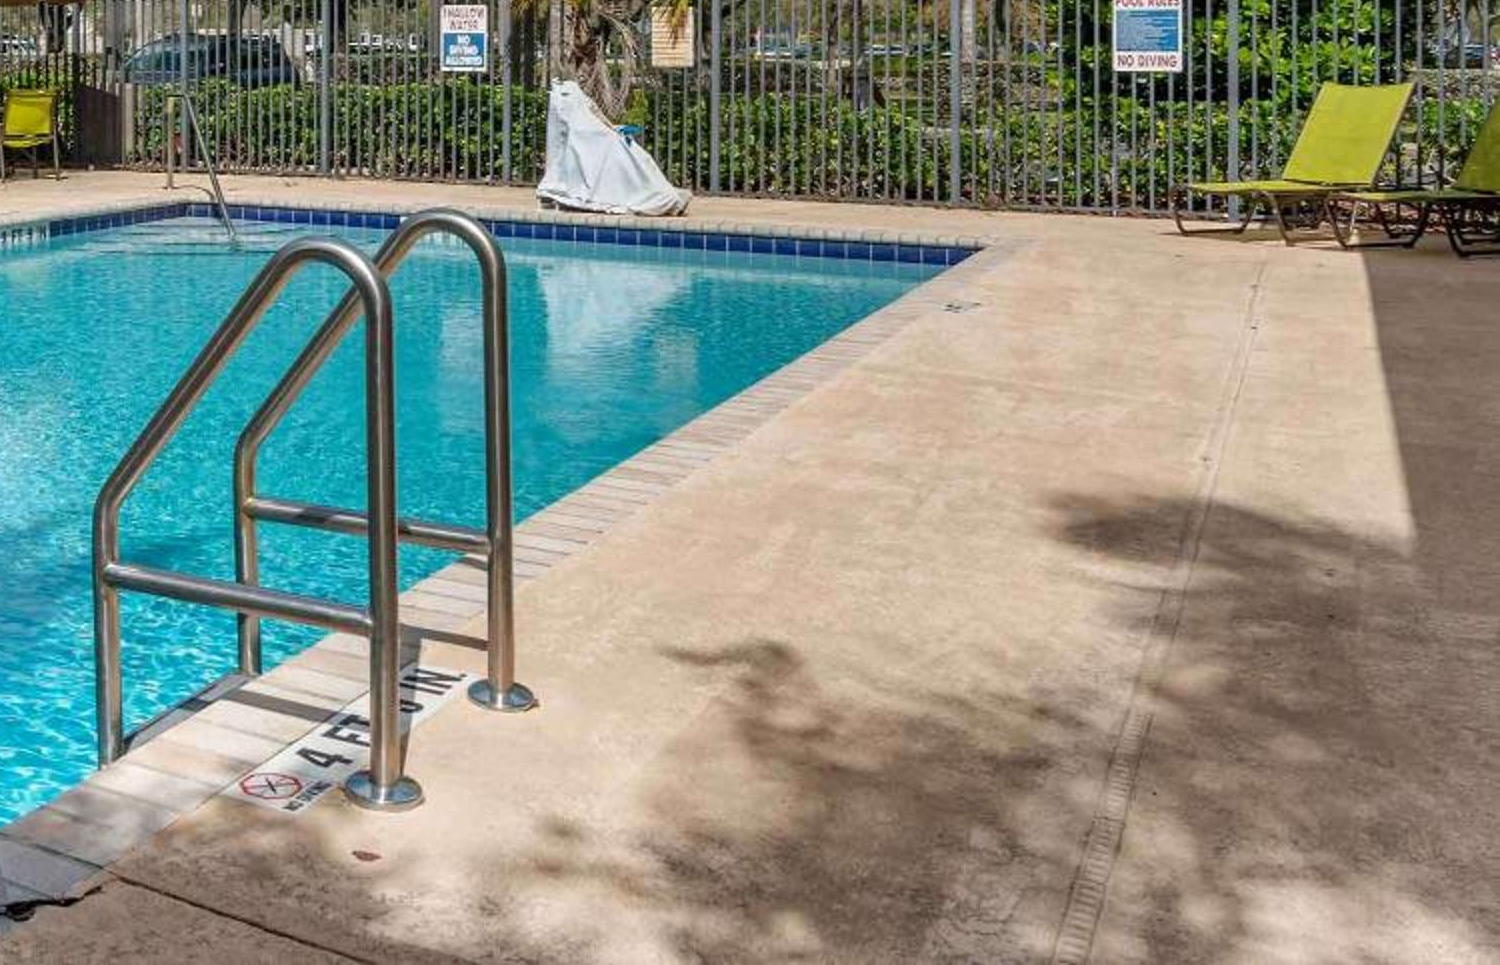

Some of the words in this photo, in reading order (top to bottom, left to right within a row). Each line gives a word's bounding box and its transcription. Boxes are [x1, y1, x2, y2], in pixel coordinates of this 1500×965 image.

[1117, 54, 1135, 68] NO
[1137, 54, 1178, 68] DIVING
[296, 746, 354, 768] 4
